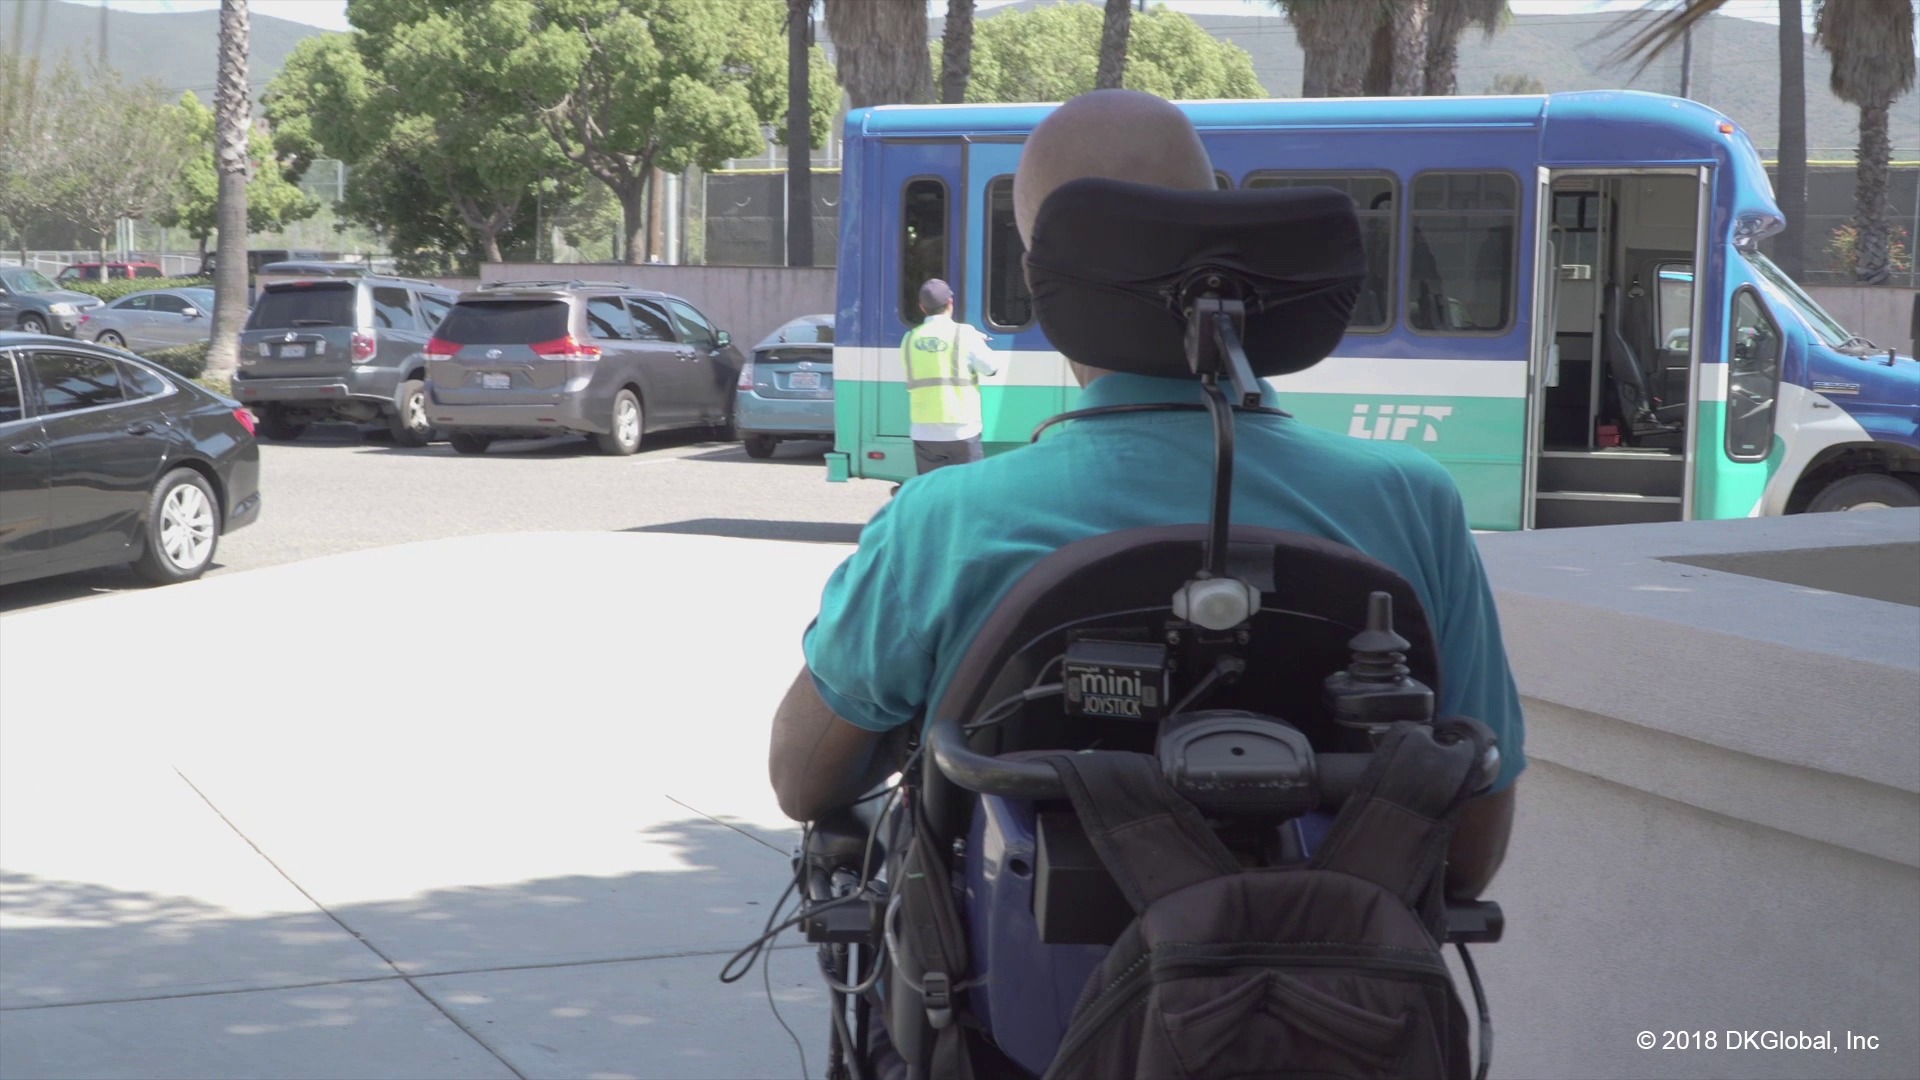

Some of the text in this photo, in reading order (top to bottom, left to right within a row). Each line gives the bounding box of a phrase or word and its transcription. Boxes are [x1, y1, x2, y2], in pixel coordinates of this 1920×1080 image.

[1347, 403, 1453, 442] LIFT
[1080, 668, 1141, 697] mini
[1082, 696, 1141, 716] JOYSTICK
